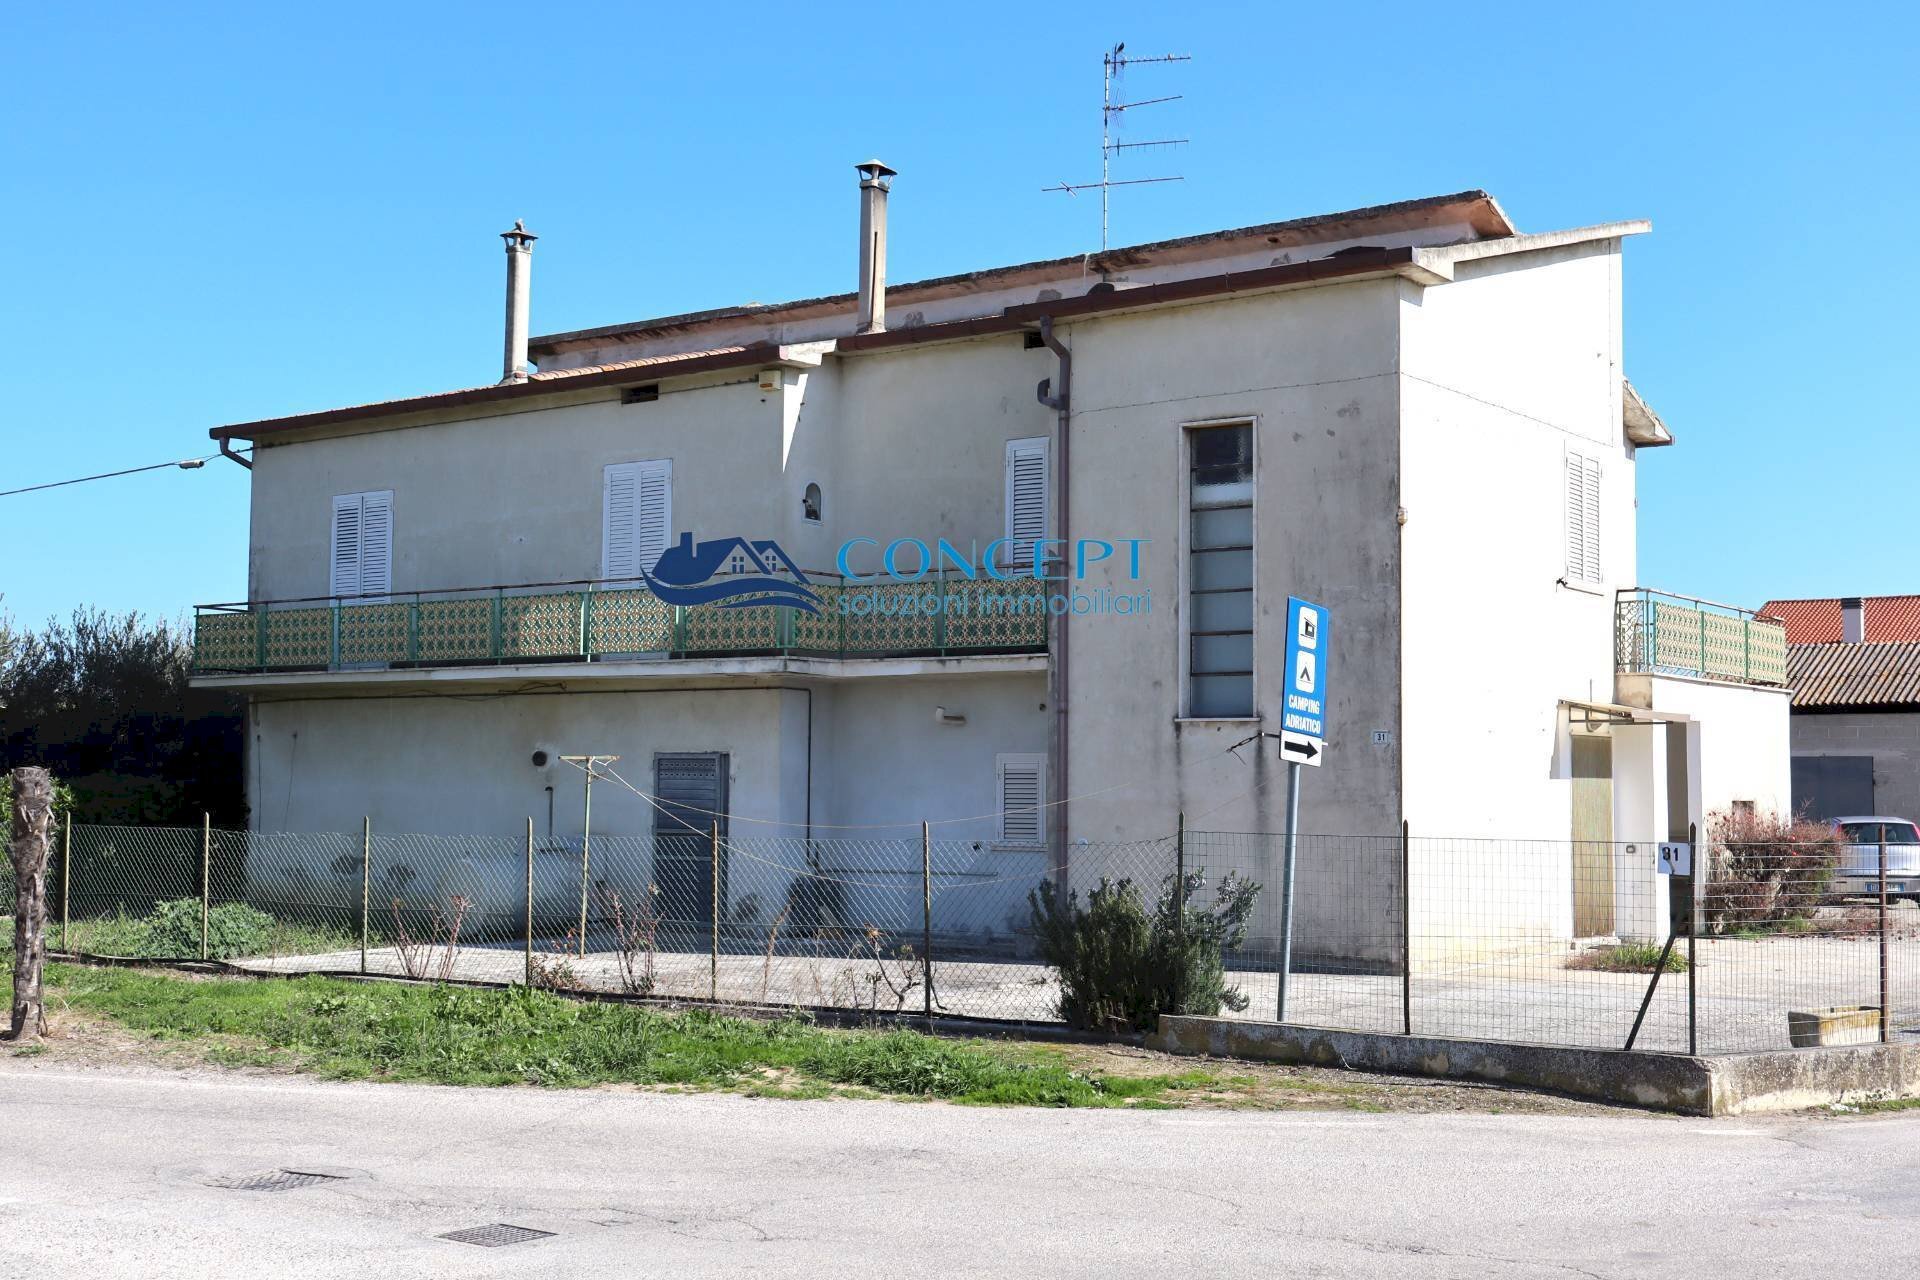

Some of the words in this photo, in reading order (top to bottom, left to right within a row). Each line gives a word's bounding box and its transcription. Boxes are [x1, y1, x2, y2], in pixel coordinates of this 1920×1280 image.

[1288, 694, 1320, 715] CAMPING
[1285, 713, 1321, 734] ADRIATICO
[1377, 733, 1385, 741] 31
